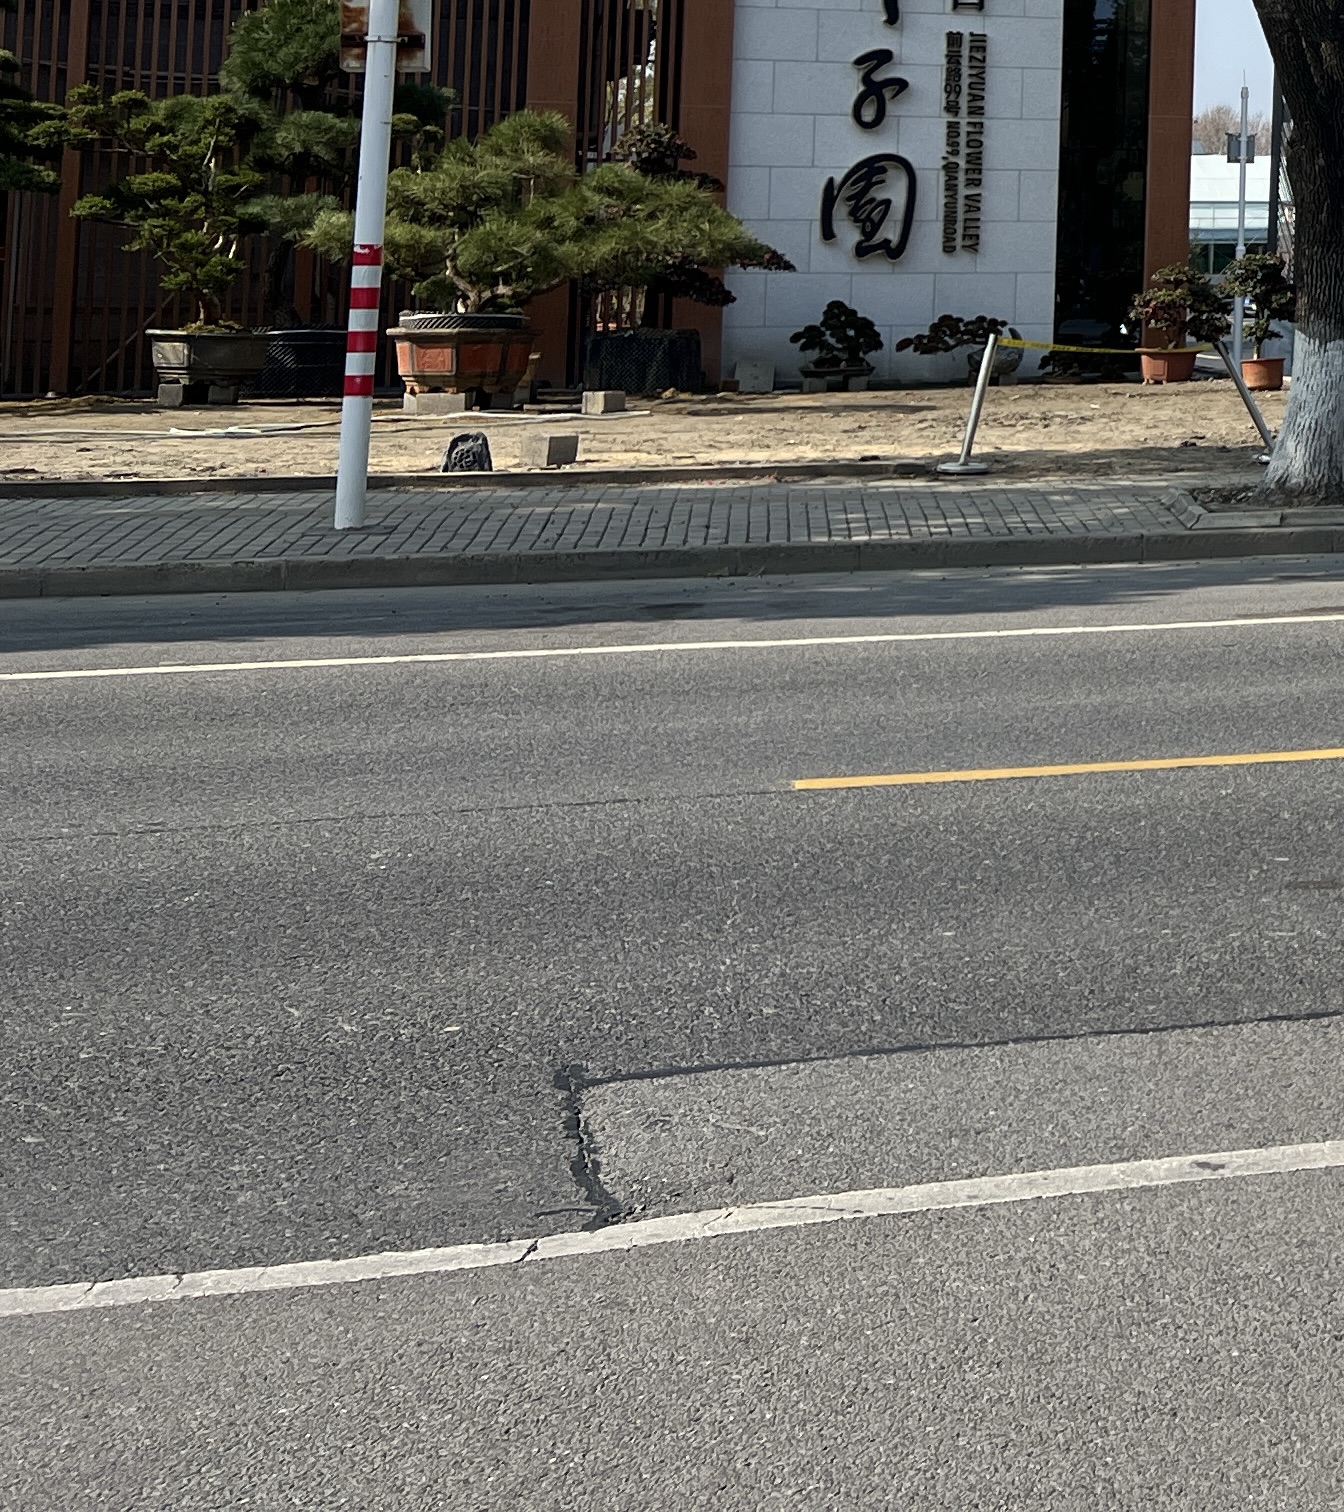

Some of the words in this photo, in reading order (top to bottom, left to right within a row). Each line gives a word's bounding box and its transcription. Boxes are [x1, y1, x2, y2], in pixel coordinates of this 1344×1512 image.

[967, 31, 987, 116] JIEZIYUAN
[964, 121, 984, 188] FLOWER
[961, 192, 982, 254] VALLEY
